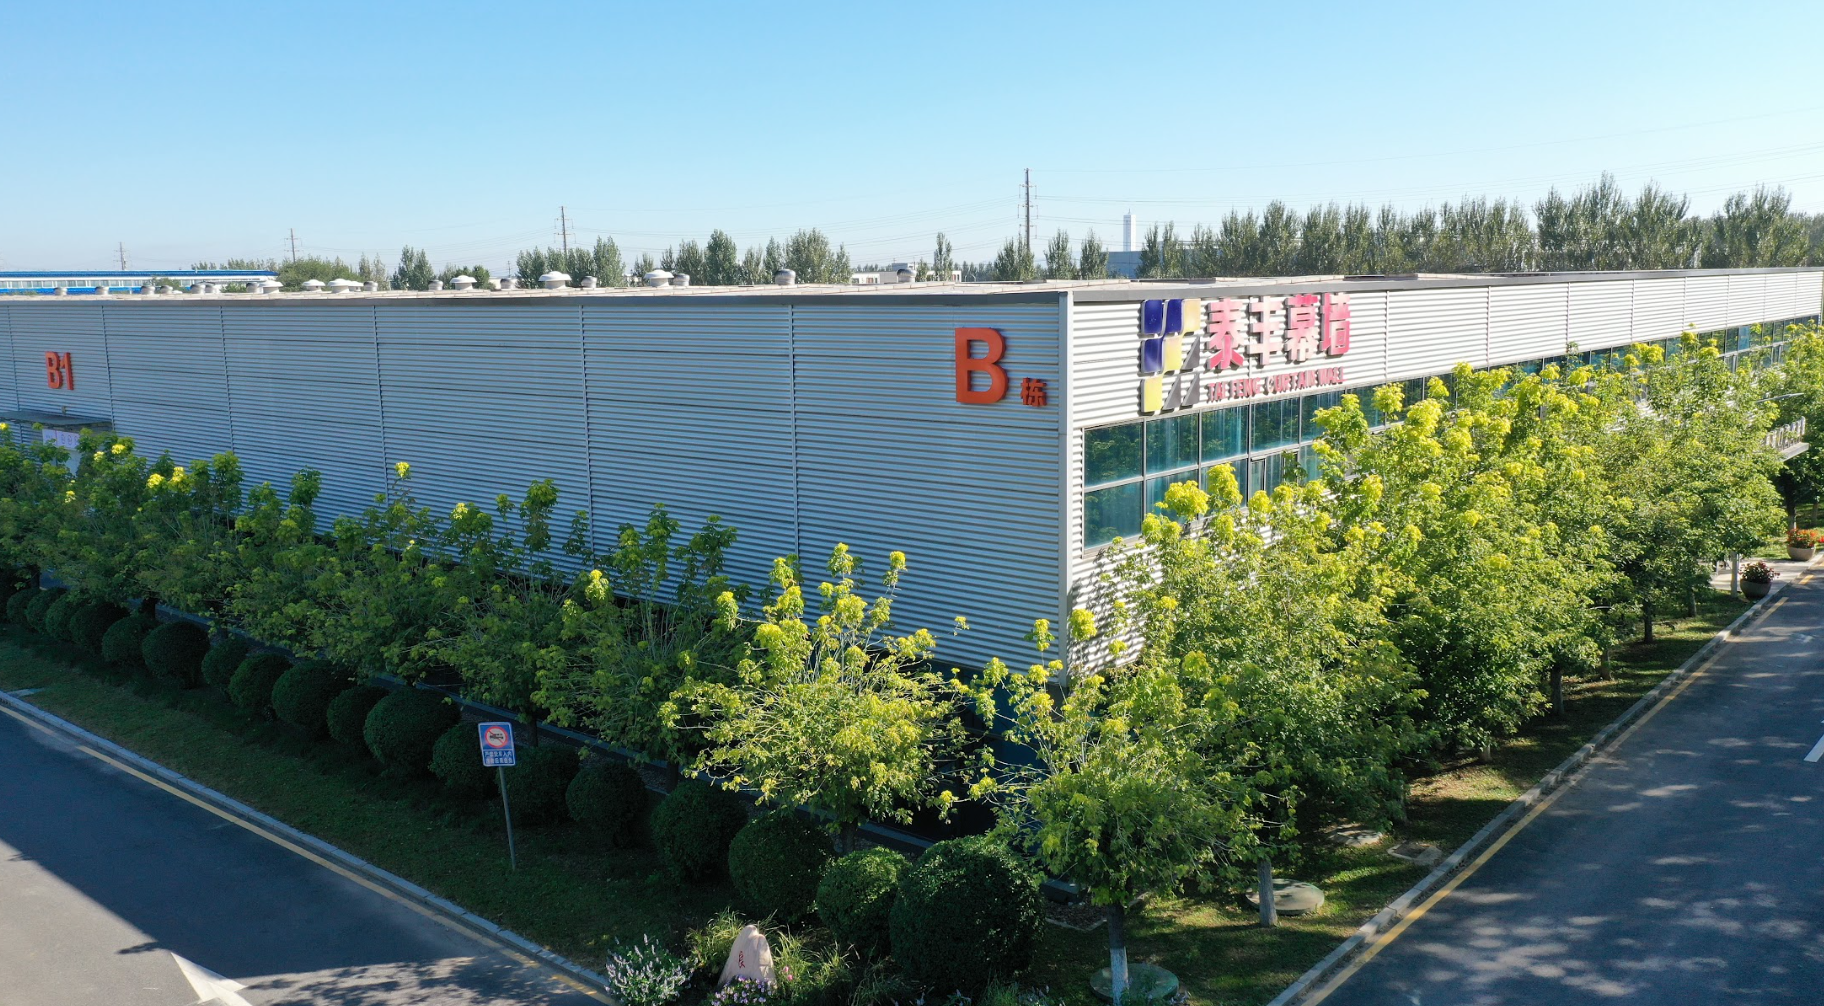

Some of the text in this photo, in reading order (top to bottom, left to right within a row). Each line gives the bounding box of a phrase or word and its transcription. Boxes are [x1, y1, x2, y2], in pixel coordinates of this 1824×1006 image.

[1207, 292, 1350, 369] 泰丰幕墙
[45, 351, 74, 390] B1
